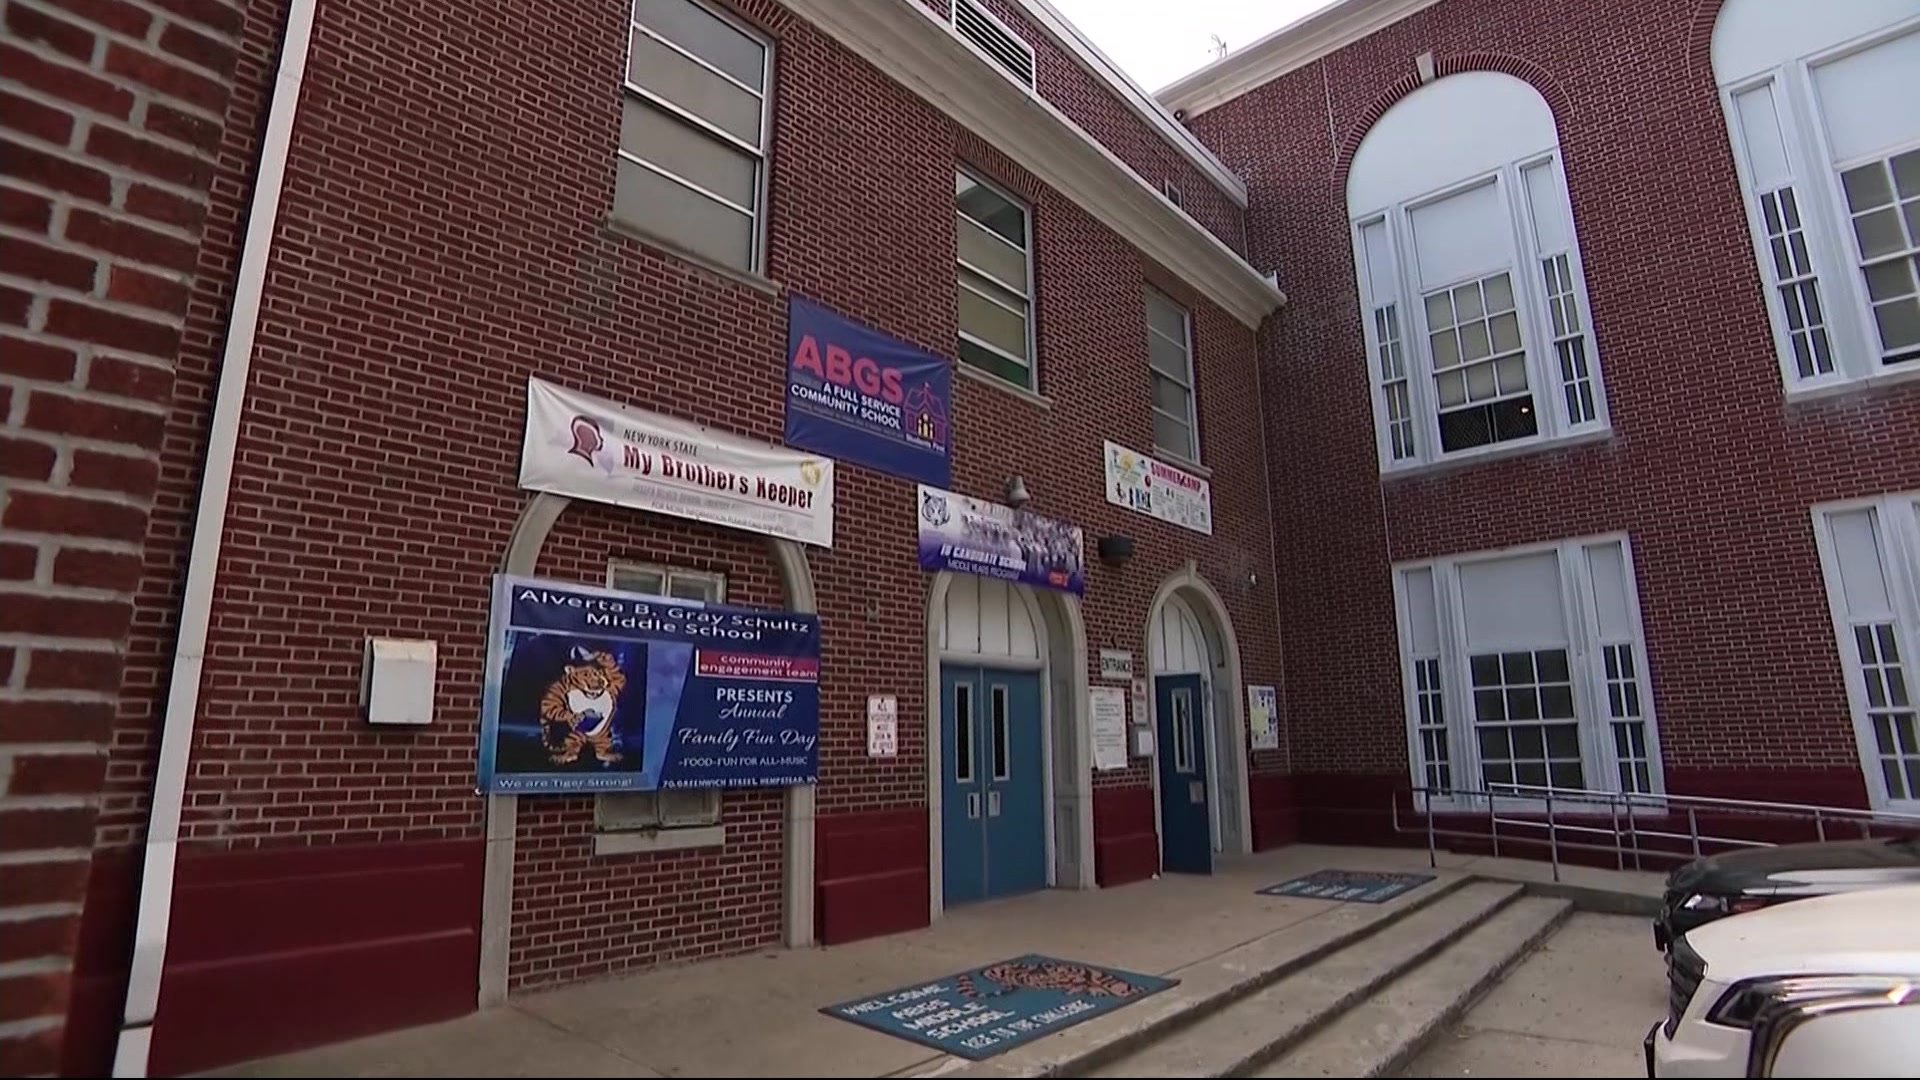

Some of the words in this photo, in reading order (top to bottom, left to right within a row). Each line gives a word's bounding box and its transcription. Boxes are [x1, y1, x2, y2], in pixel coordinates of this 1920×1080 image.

[793, 334, 905, 405] ABGS
[791, 384, 858, 415] COMMUNITY
[861, 408, 901, 430] SCHOOL
[823, 383, 831, 394] A
[834, 386, 858, 403] FULL
[861, 394, 901, 418] SERVICE
[623, 429, 647, 444] NEW
[648, 433, 671, 449] YORK
[673, 440, 698, 457] STATE
[624, 445, 652, 476] My
[756, 475, 813, 509] Keeper
[520, 589, 624, 613] Alverta
[634, 603, 657, 617] B.
[667, 607, 723, 626] Gray
[731, 614, 809, 634] Schultz
[586, 612, 677, 633] Middle
[685, 622, 761, 641] School
[700, 663, 783, 676] engagement
[786, 668, 818, 679] team
[720, 655, 792, 669] community
[1101, 656, 1131, 672] ENTRANCE
[716, 687, 793, 703] PRESENTS
[719, 702, 787, 719] Annual
[678, 727, 739, 752] Family
[743, 728, 775, 745] Fun
[779, 728, 816, 751] Day
[740, 757, 757, 767] FOR
[499, 779, 521, 788] We
[526, 779, 548, 788] are
[552, 778, 583, 791] Tiger
[587, 777, 632, 788] Strong!
